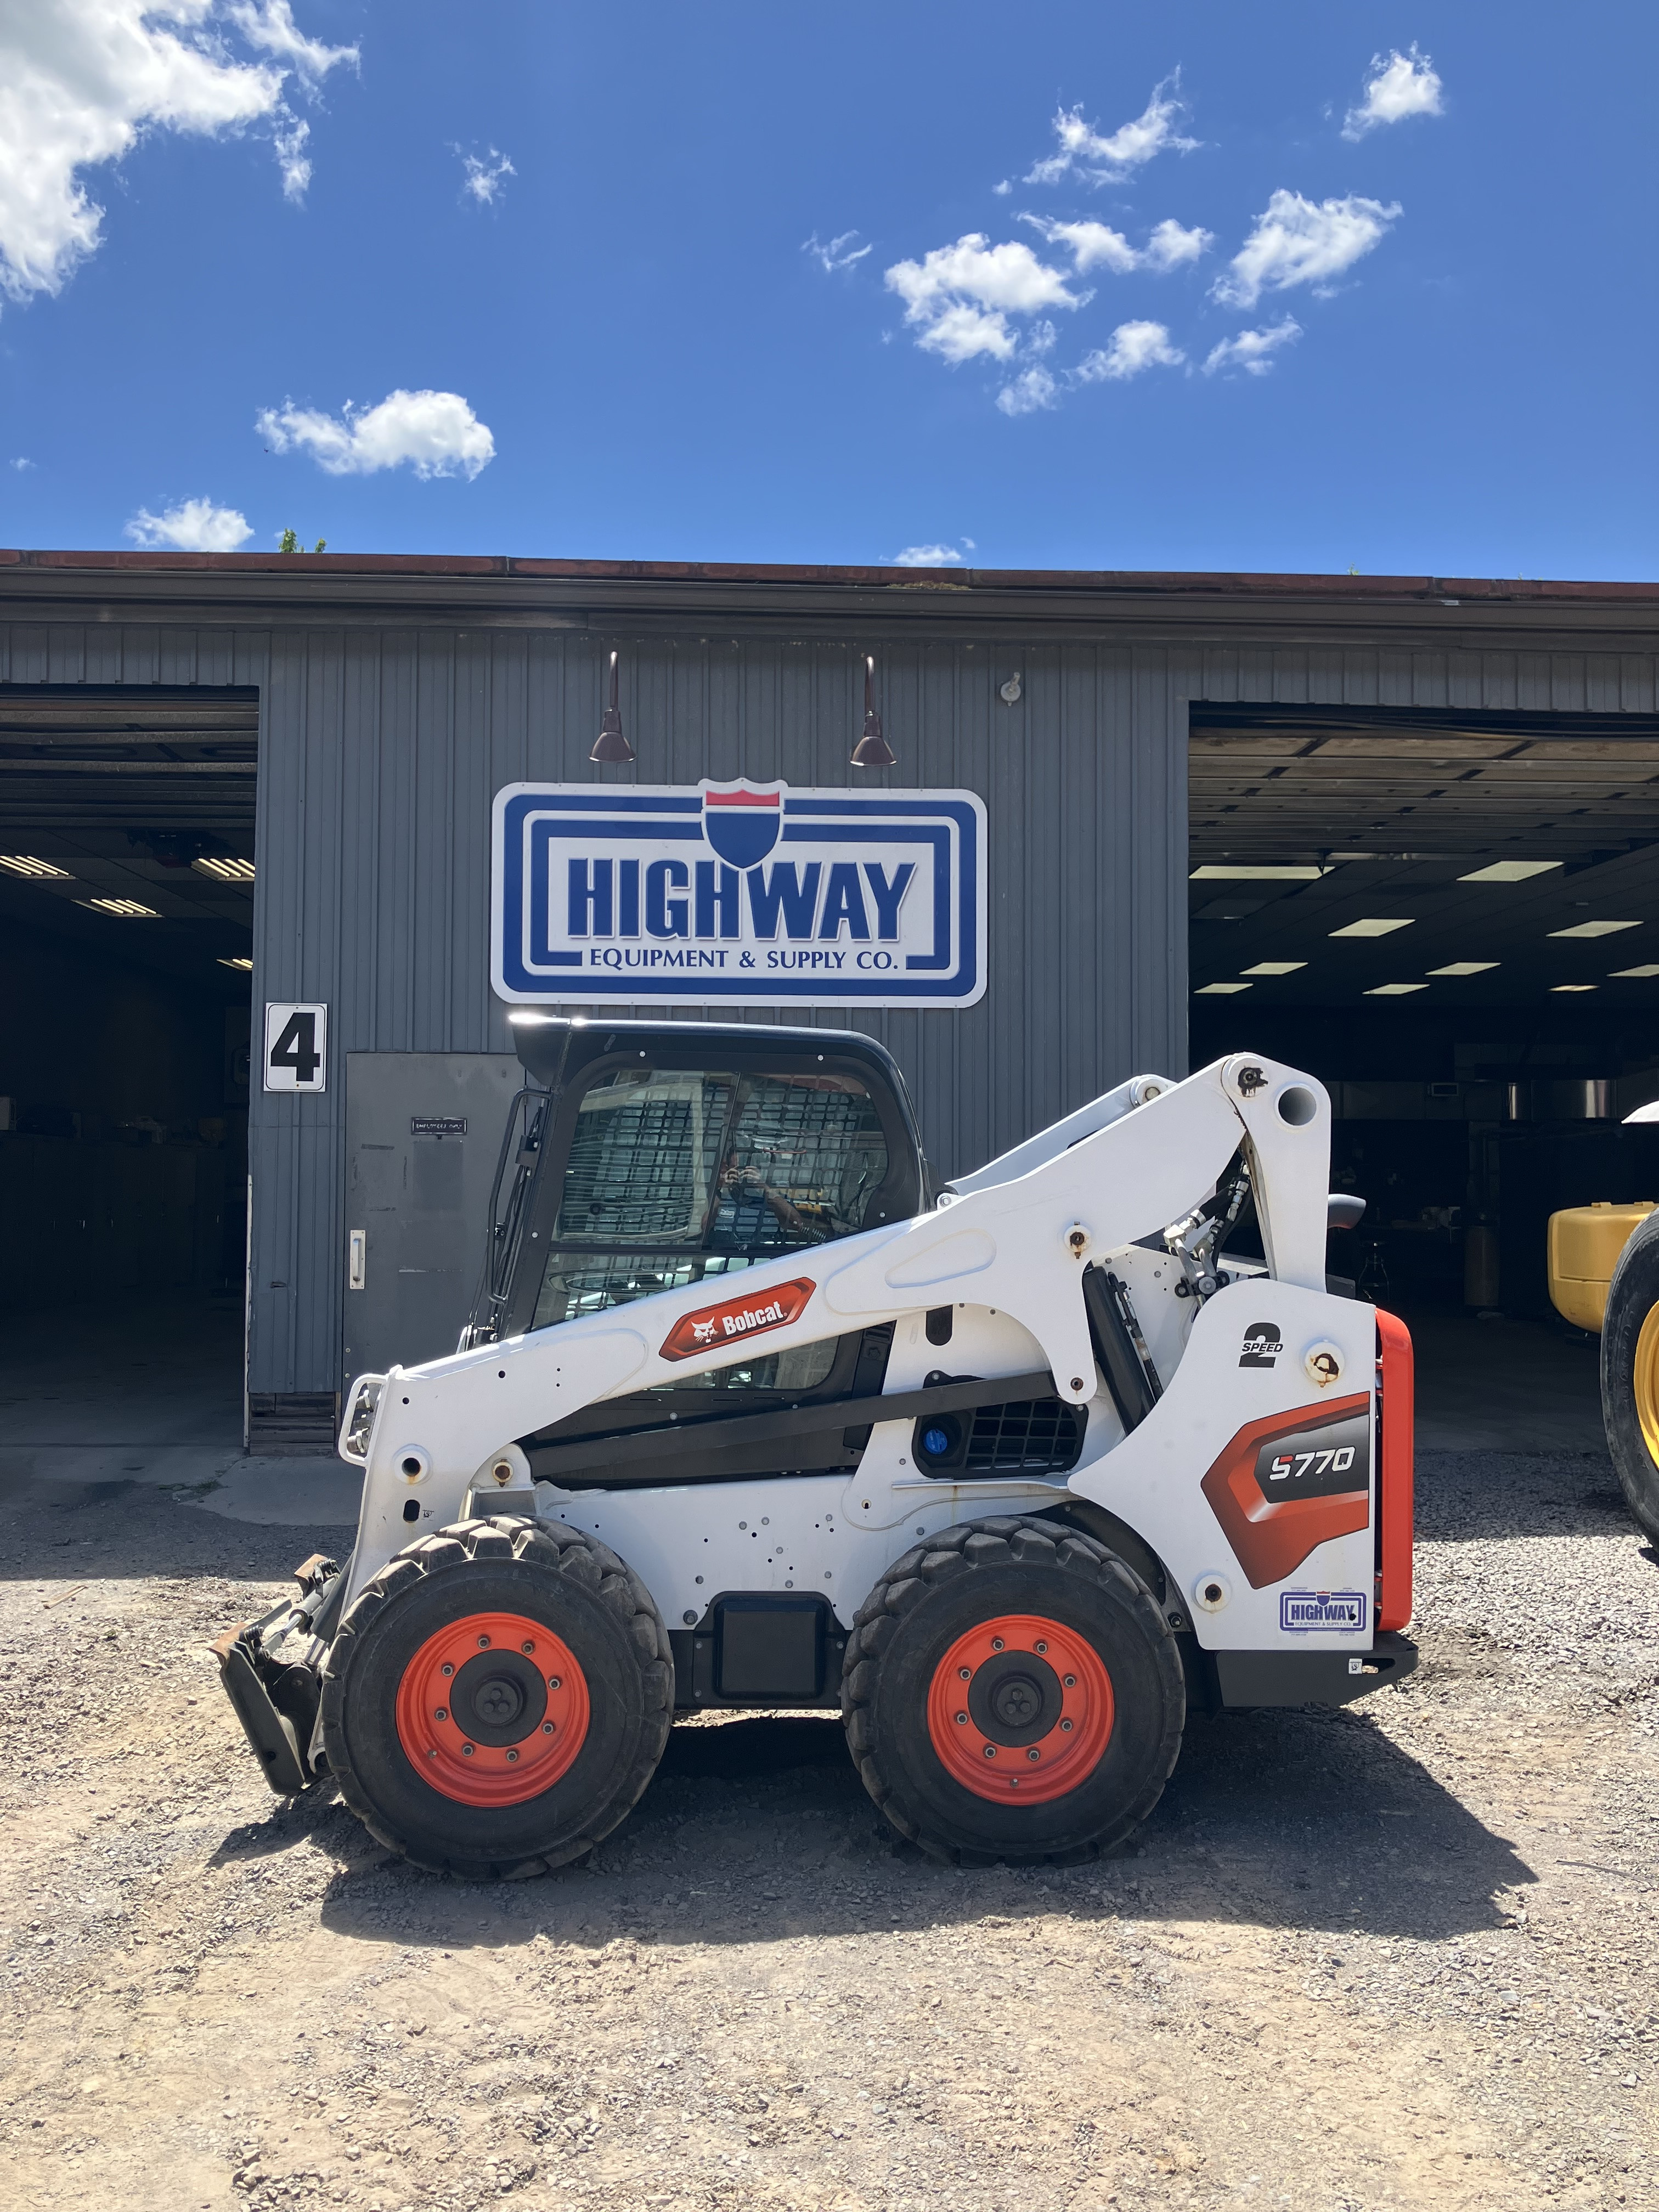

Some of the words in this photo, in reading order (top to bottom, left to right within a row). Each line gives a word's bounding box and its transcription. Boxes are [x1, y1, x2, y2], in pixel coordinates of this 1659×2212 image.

[567, 857, 917, 941] HIGHWAY
[590, 949, 729, 970] EQUIPMENT
[739, 950, 756, 969] &
[767, 950, 847, 969] SUPPLY
[856, 951, 898, 969] CO.
[270, 1012, 320, 1082] 4
[721, 1301, 784, 1335] Bobcat
[1238, 1322, 1281, 1368] 2
[1242, 1342, 1284, 1352] SPEED
[1269, 1446, 1356, 1481] S770
[1291, 1604, 1355, 1621] HIGHWAY
